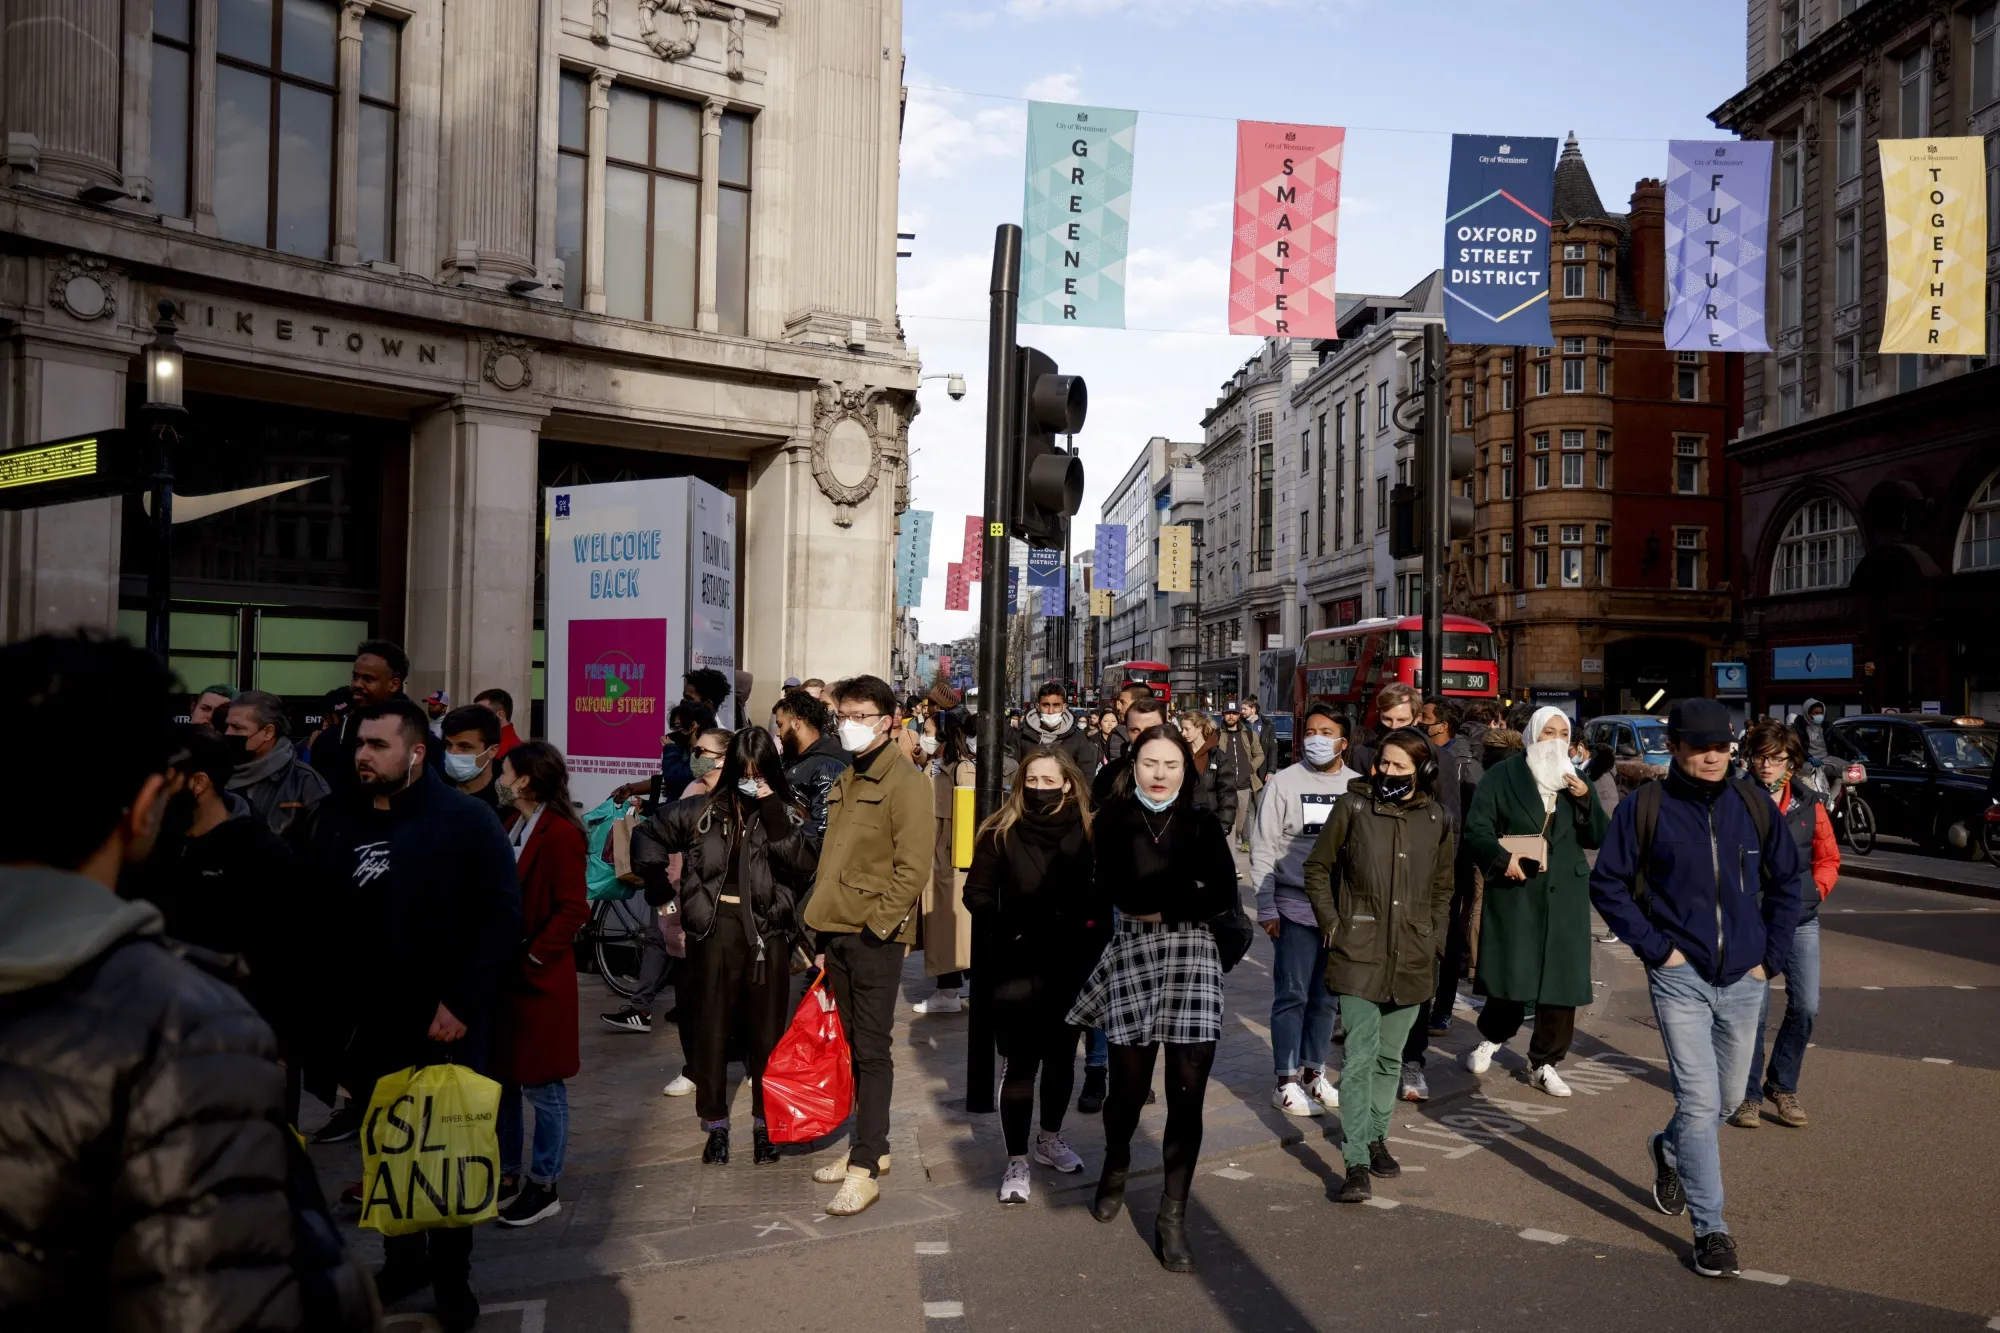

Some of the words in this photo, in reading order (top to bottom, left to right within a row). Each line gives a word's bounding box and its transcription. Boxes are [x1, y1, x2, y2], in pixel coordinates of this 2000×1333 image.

[1056, 121, 1066, 130] City
[1074, 123, 1108, 133] Westminster
[1264, 142, 1275, 150] City
[1282, 144, 1315, 152] Westminster
[1479, 156, 1490, 164] City
[1497, 156, 1528, 164] Westminster
[1063, 139, 1088, 320] GREENER
[1275, 158, 1296, 334] SMARTER
[1457, 226, 1537, 243] OXFORD
[1460, 248, 1533, 264] STREET
[1705, 174, 1724, 347] FUTURE
[1928, 168, 1944, 344] TOGETHER
[1452, 270, 1540, 286] DISTRICT
[172, 300, 437, 364] NIKETOWN
[574, 530, 662, 564] WELCOME
[702, 530, 720, 568] THANK
[720, 538, 730, 572] YOU
[909, 519, 919, 574] GREENER
[974, 526, 984, 580] SMARTER
[590, 568, 640, 600] BACK
[584, 663, 616, 680] PRESS
[620, 664, 646, 680] PLAY
[1467, 675, 1484, 688] 390
[575, 696, 614, 712] OXFORD
[618, 696, 656, 714] STREET
[366, 1094, 446, 1156] ISL
[440, 1114, 463, 1123] RIVER
[465, 1112, 492, 1122] ISLAND
[363, 1156, 495, 1220] AND
